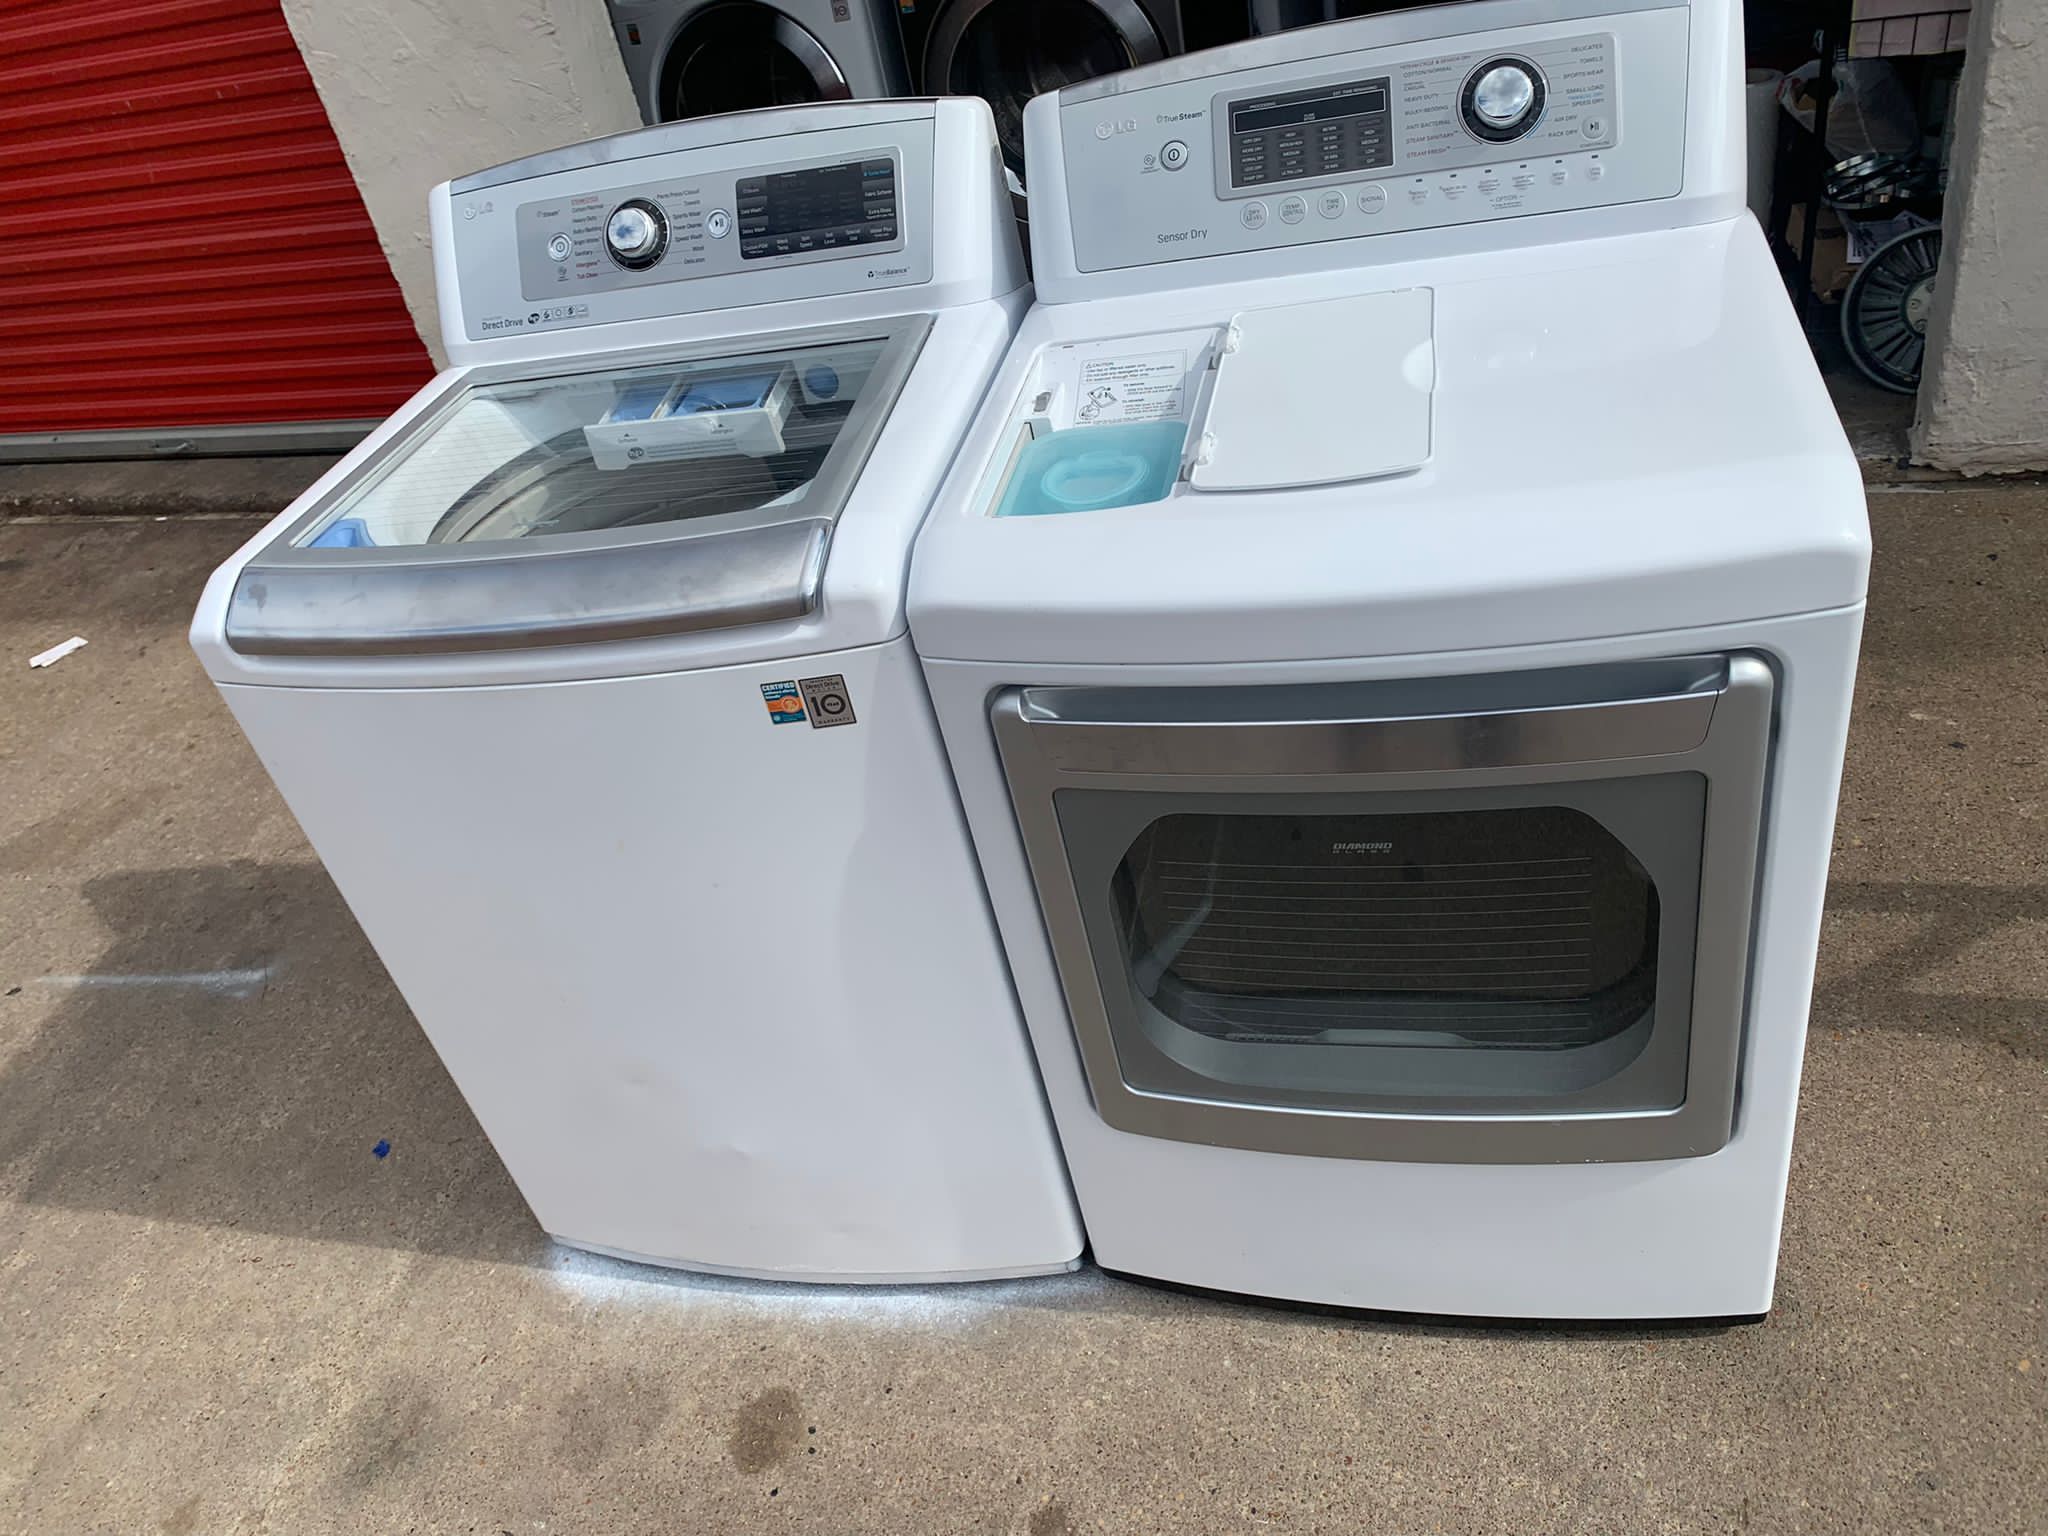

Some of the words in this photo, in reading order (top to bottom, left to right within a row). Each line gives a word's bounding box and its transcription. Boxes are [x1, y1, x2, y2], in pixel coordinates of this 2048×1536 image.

[1157, 231, 1189, 245] Sensor
[1190, 228, 1208, 241] Dry
[481, 321, 503, 331] Direct
[504, 318, 524, 329] Drive
[762, 682, 795, 691] CERTIFIED
[810, 694, 847, 717] 10
[1333, 842, 1393, 850] DIAMOND
